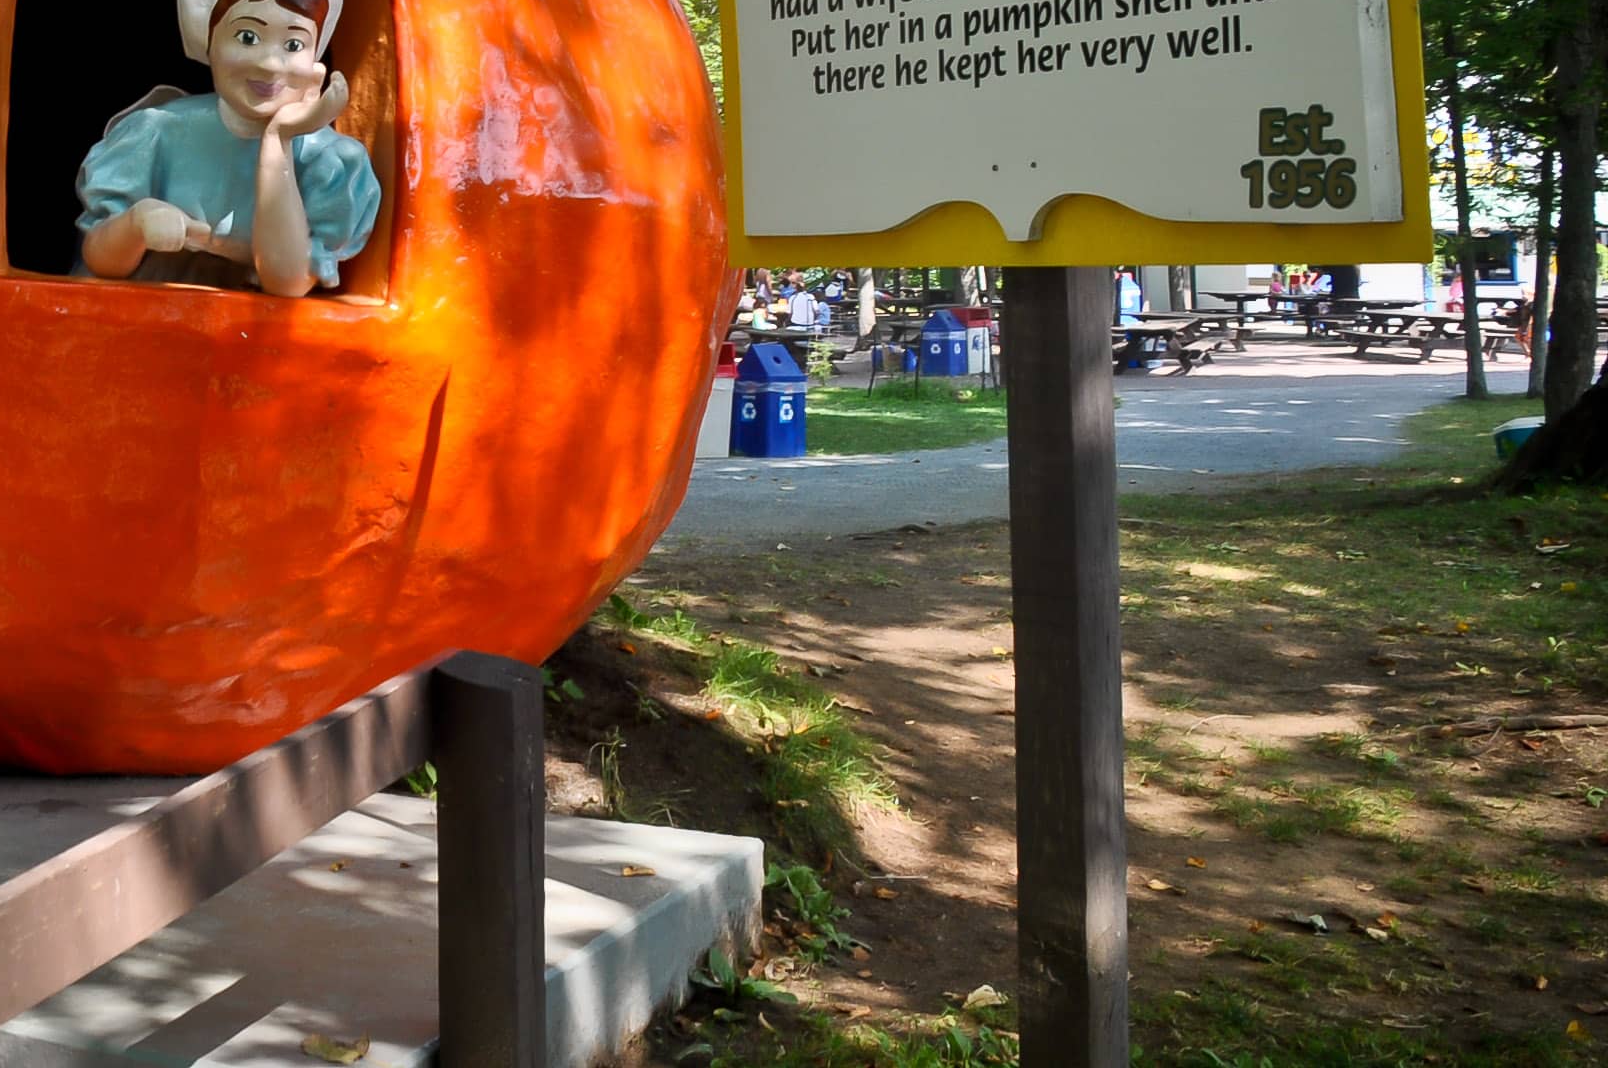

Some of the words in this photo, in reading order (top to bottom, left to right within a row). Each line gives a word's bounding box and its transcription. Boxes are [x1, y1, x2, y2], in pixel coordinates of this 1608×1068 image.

[791, 24, 837, 58] Put
[844, 18, 890, 51] her
[899, 11, 925, 45] in
[934, 13, 952, 40] a
[812, 61, 885, 95] there
[895, 53, 928, 87] he
[938, 44, 1007, 89] kept
[1017, 39, 1071, 74] her
[1080, 33, 1155, 74] very
[1166, 14, 1253, 59] well.
[1258, 104, 1346, 157] Est.
[1240, 157, 1358, 210] 1956
